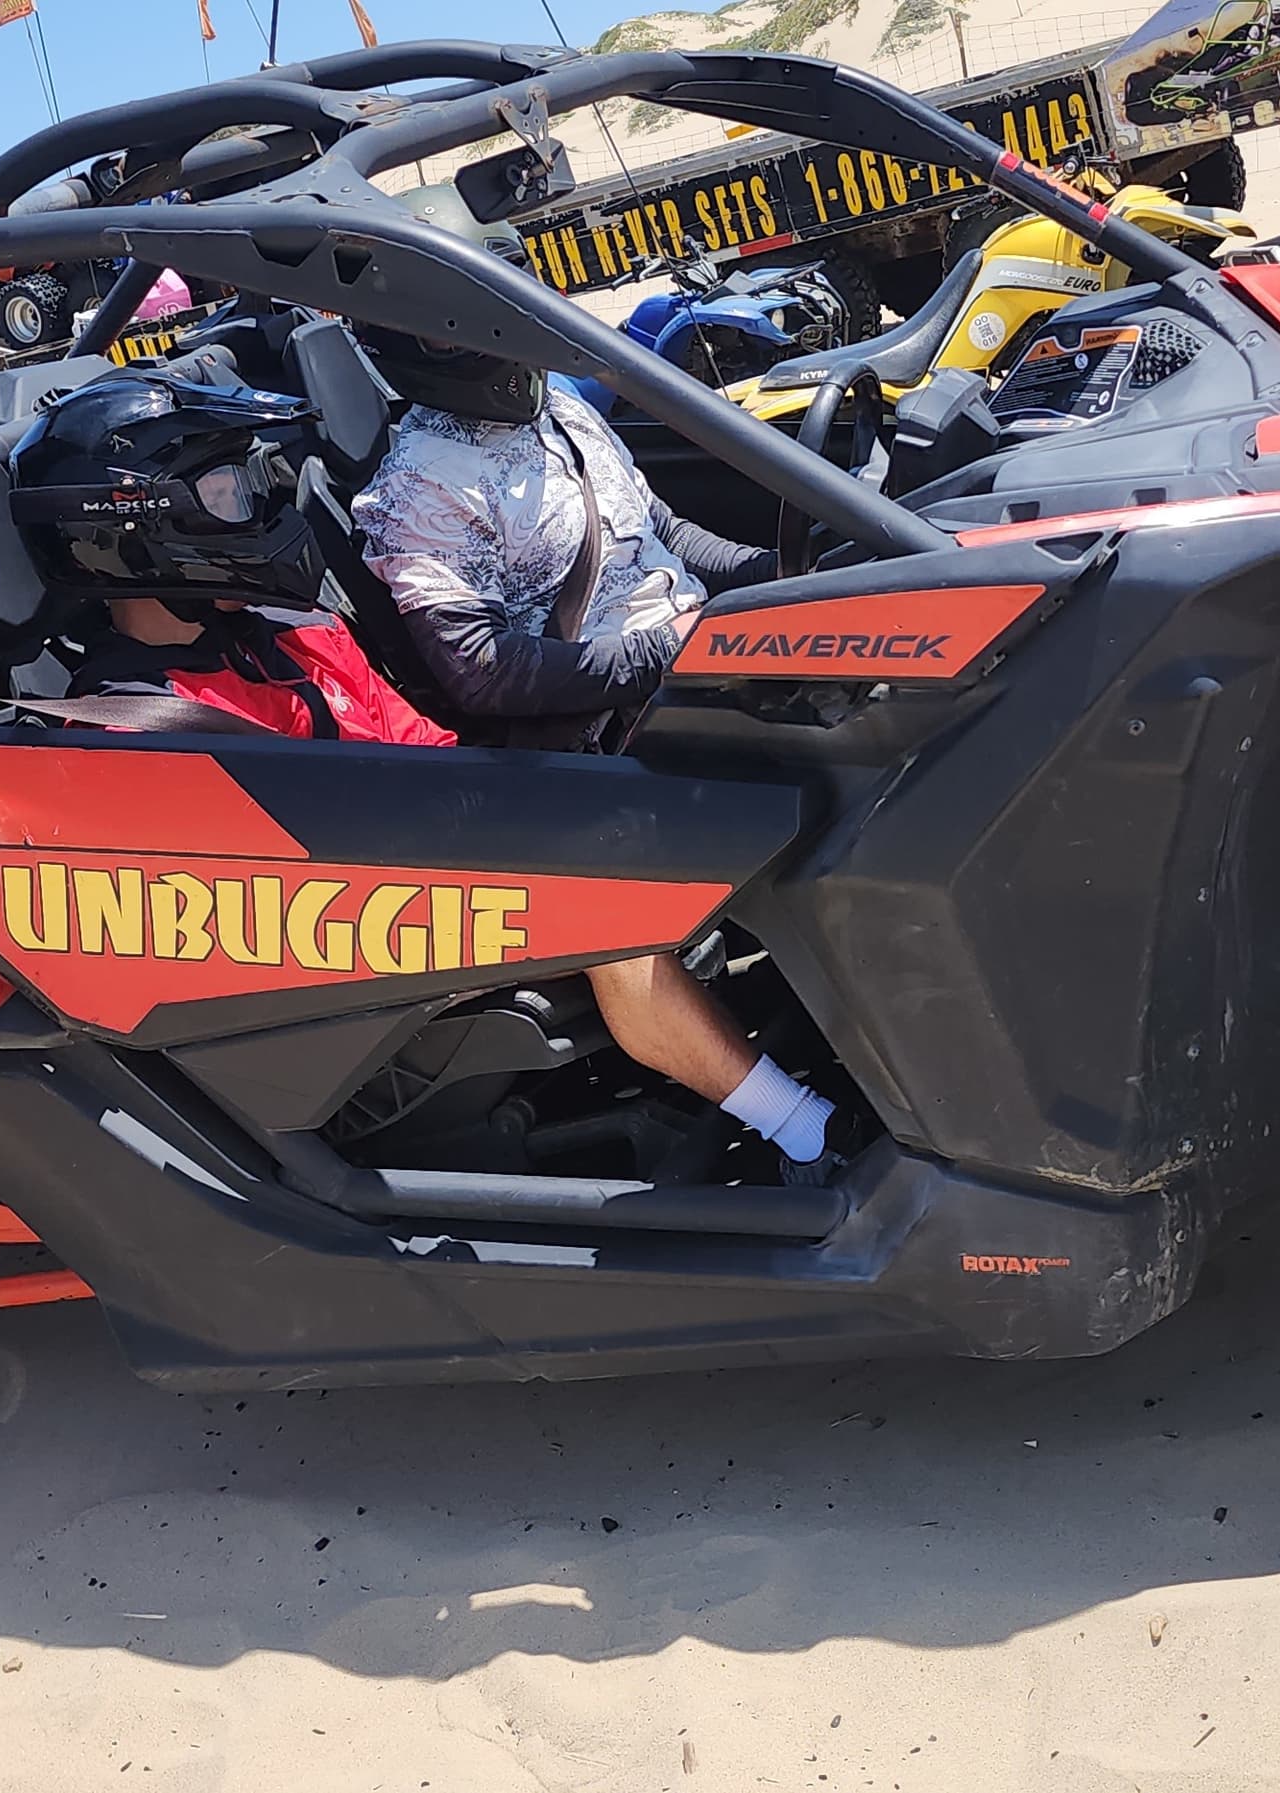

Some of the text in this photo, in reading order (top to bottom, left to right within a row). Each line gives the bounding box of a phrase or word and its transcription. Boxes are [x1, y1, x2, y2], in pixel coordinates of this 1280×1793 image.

[695, 174, 777, 251] SETS
[1063, 275, 1102, 293] EURO
[707, 633, 952, 659] MAVERICK
[961, 1254, 1039, 1274] ROTAX
